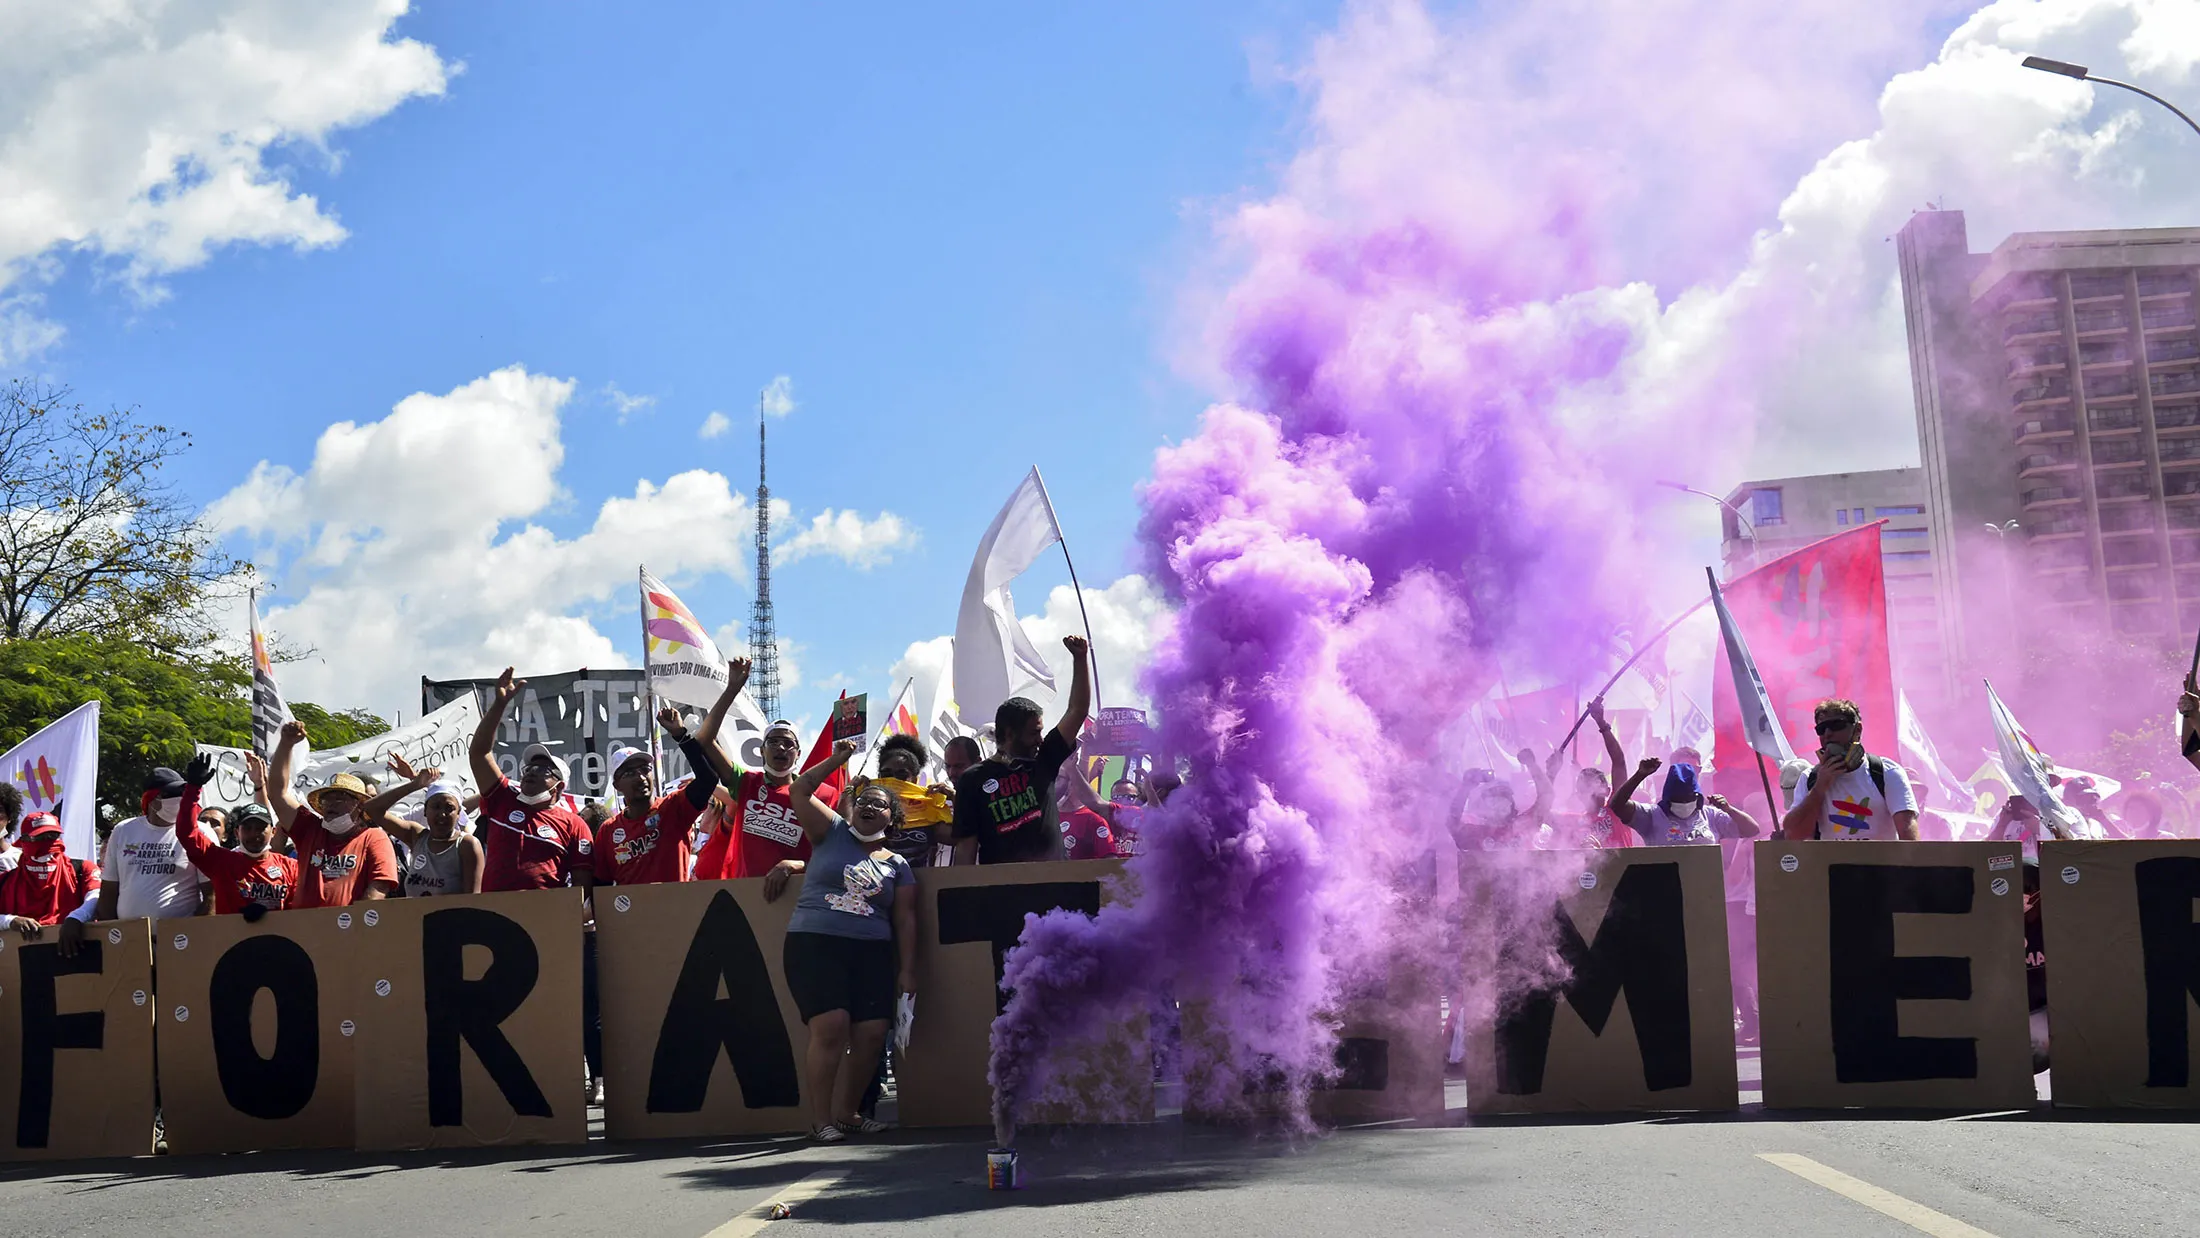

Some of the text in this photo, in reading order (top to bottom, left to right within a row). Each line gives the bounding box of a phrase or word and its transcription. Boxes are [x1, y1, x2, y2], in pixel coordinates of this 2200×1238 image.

[693, 663, 711, 679] UMA
[146, 842, 172, 850] PRECISO
[137, 850, 175, 858] ARRANCAR
[141, 863, 176, 875] FUTURO
[250, 882, 288, 899] MAIS
[17, 889, 800, 1148] FORA
